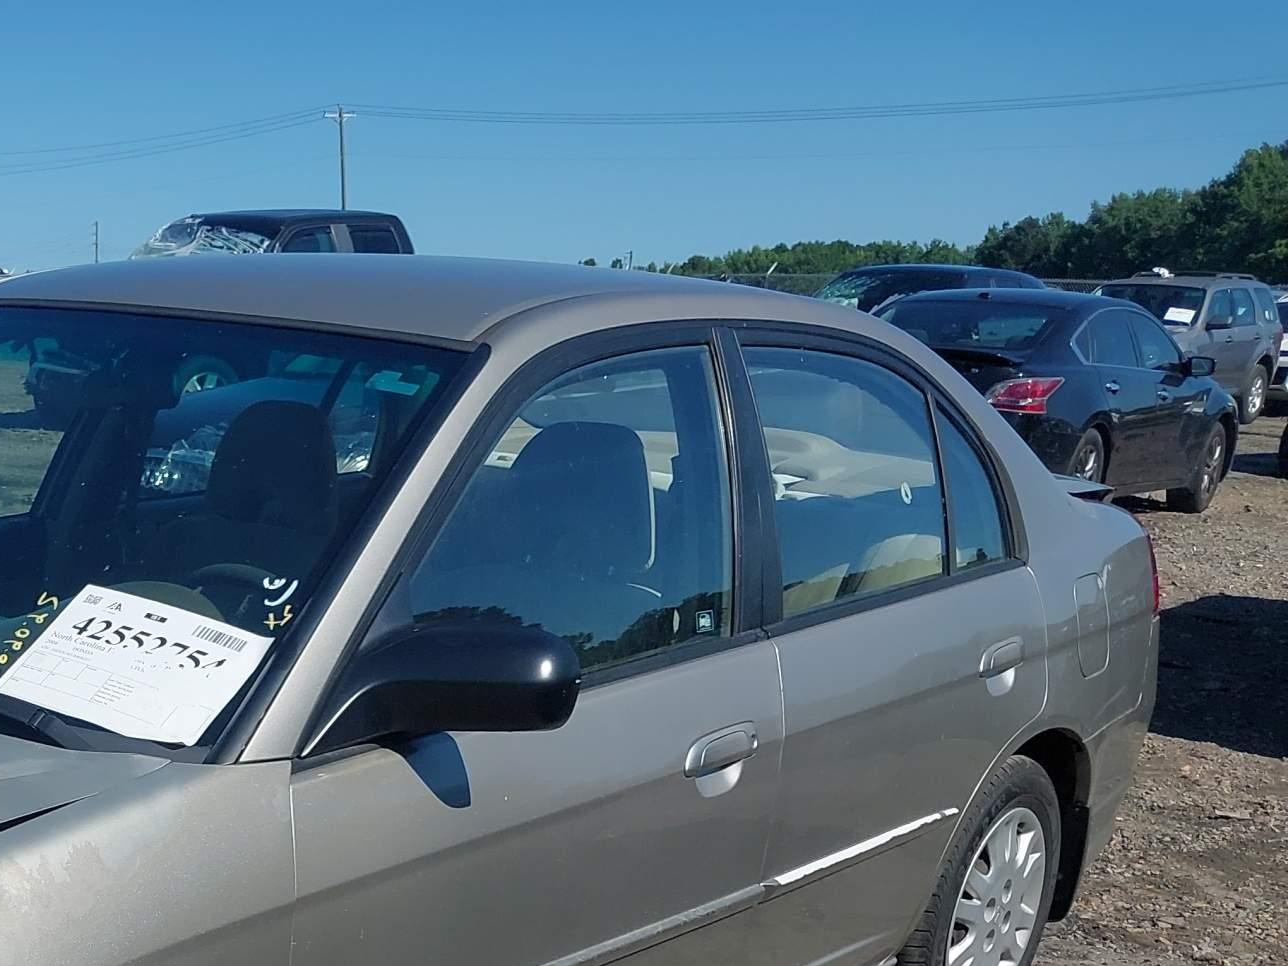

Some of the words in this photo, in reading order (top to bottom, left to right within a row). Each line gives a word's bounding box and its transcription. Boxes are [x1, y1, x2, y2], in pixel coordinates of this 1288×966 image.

[50, 631, 72, 642] North
[74, 637, 106, 652] Carolina
[72, 617, 227, 675] 42552754
